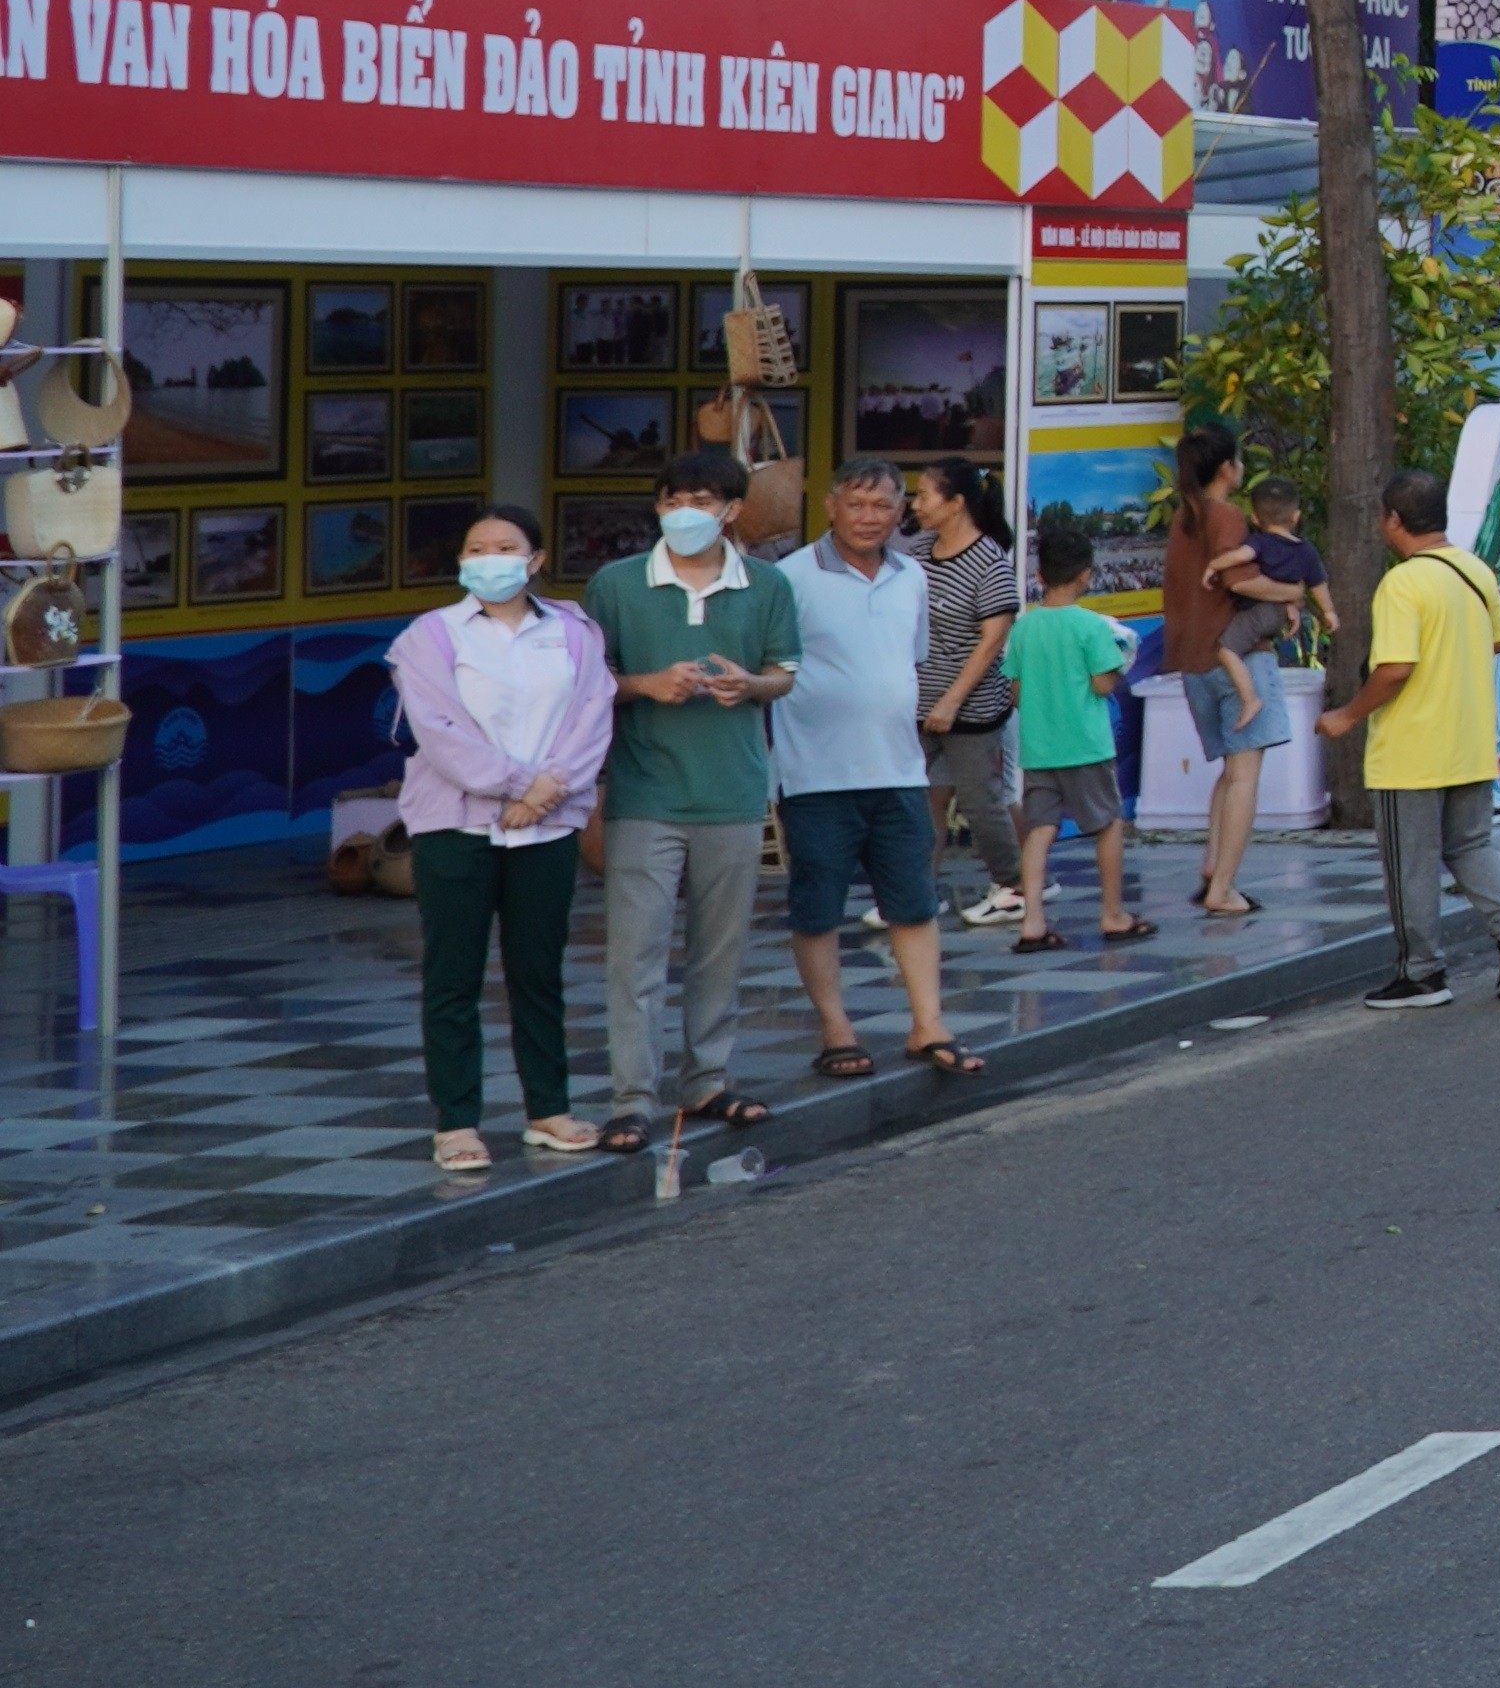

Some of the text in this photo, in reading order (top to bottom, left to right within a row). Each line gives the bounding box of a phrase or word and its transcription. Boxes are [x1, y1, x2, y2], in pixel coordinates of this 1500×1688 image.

[482, 8, 580, 119] ĐẢO
[593, 16, 706, 128] TỈNH
[718, 41, 820, 134] KIÊN
